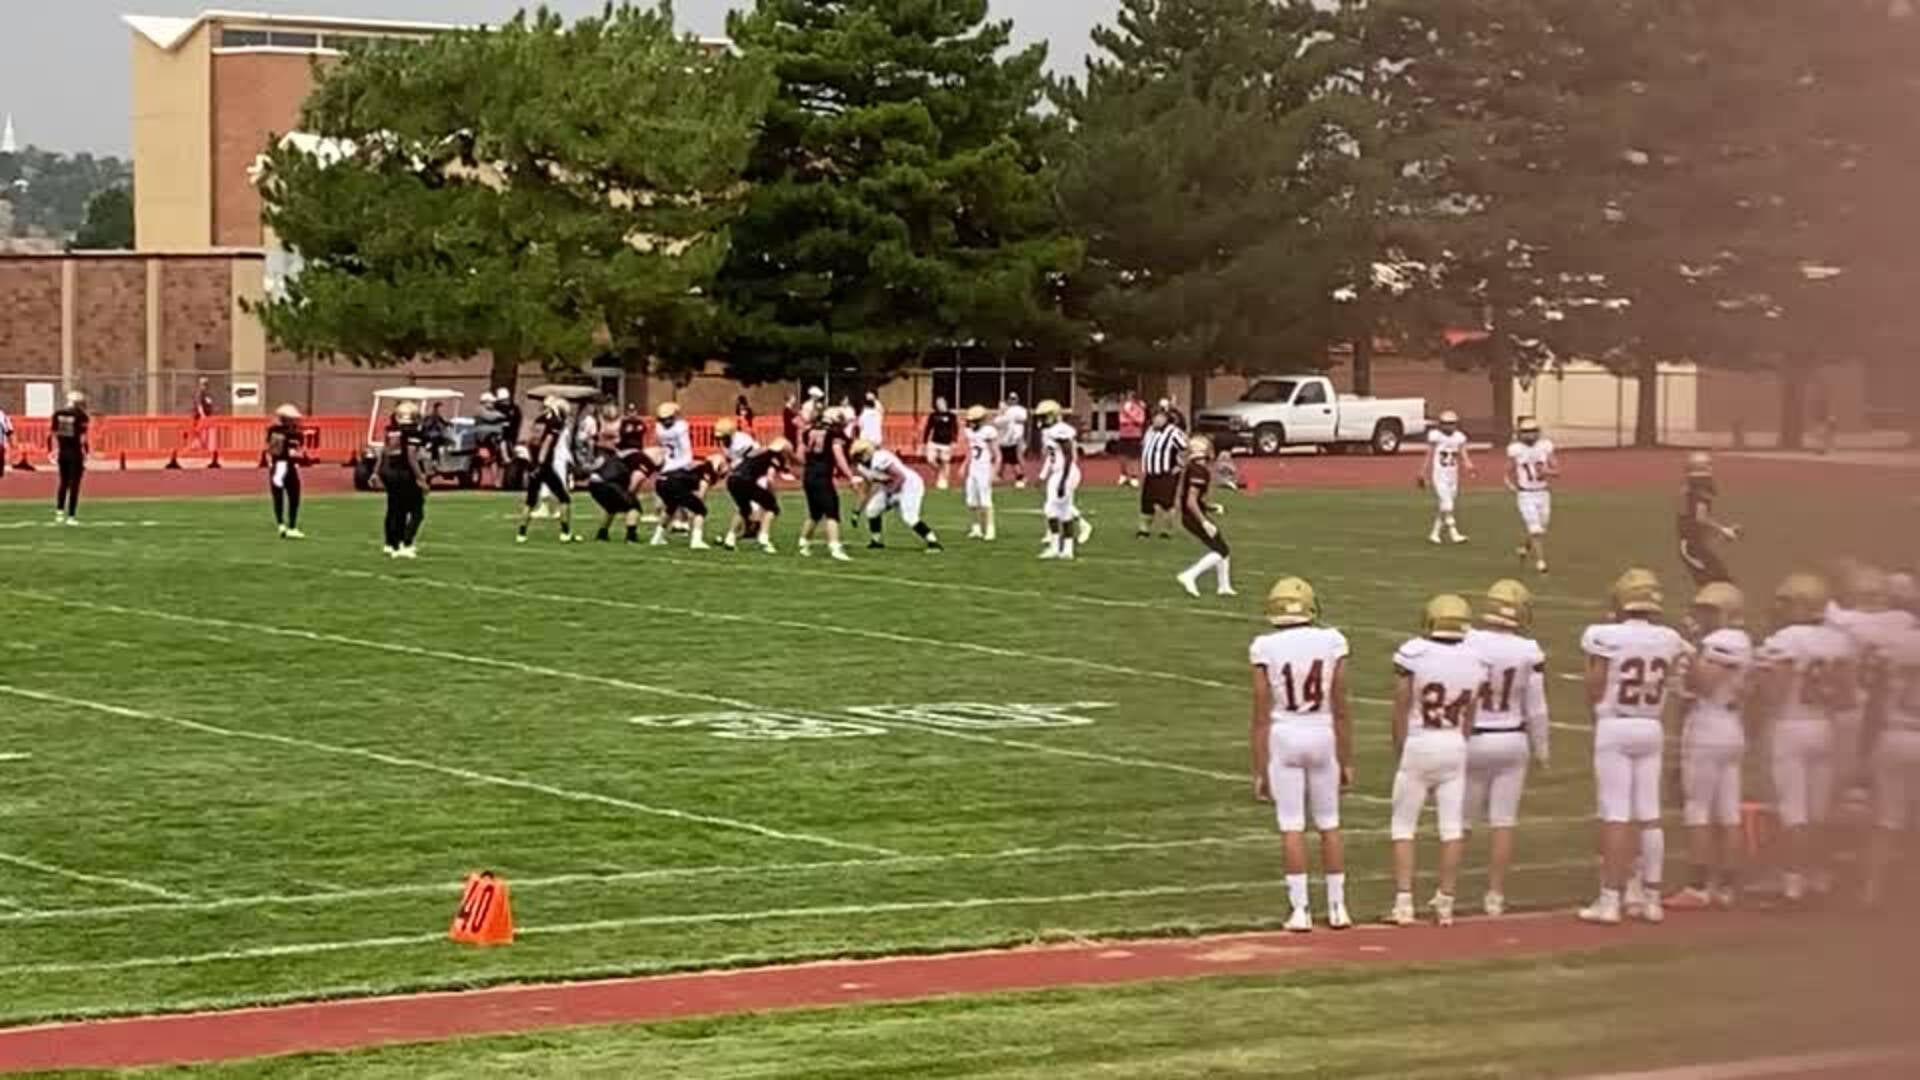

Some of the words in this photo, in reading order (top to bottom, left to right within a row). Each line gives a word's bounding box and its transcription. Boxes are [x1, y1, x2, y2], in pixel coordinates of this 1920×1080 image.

[1281, 659, 1325, 712] 14
[1422, 682, 1472, 729] 24
[1618, 656, 1667, 705] 23
[457, 880, 495, 935] 40
